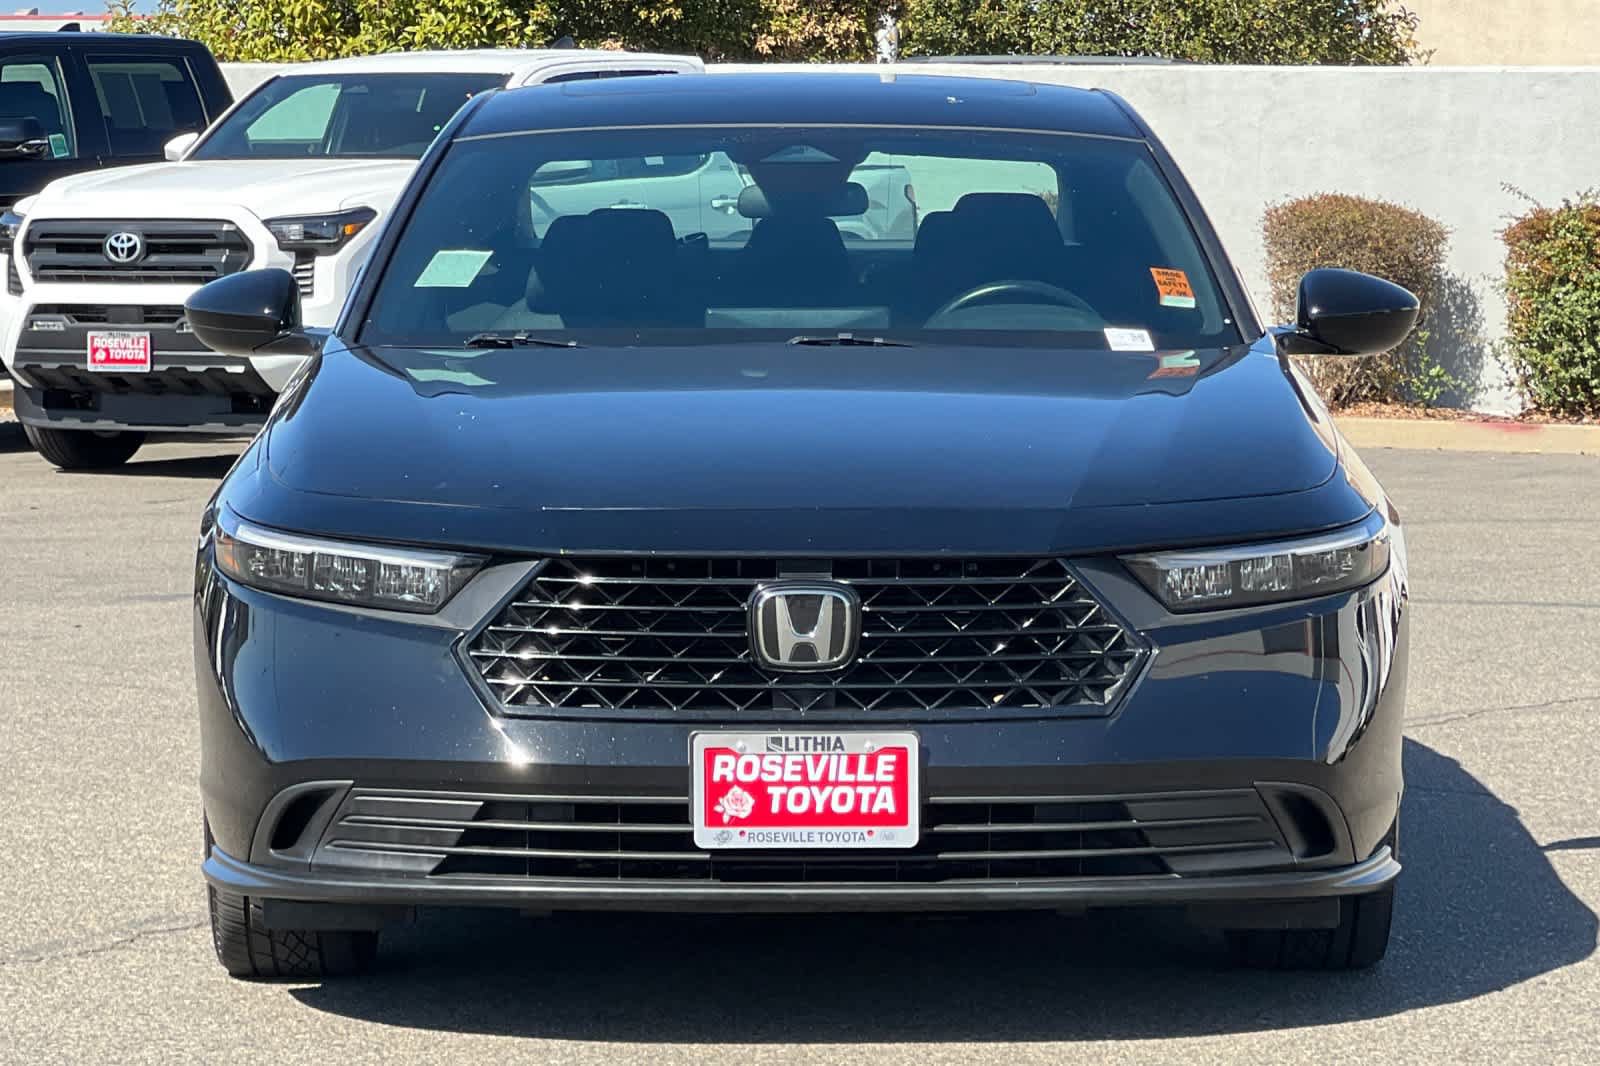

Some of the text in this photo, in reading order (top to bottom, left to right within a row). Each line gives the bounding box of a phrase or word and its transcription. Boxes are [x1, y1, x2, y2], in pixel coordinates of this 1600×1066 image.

[94, 337, 146, 349] ROSEVILLE
[109, 349, 146, 360] TOYOTA
[784, 736, 845, 752] LITHIA
[712, 754, 897, 783] ROSEVILLE
[767, 785, 897, 814] TOYOTA
[747, 831, 815, 844] ROSEVILLE
[818, 831, 866, 843] TOYOTA
